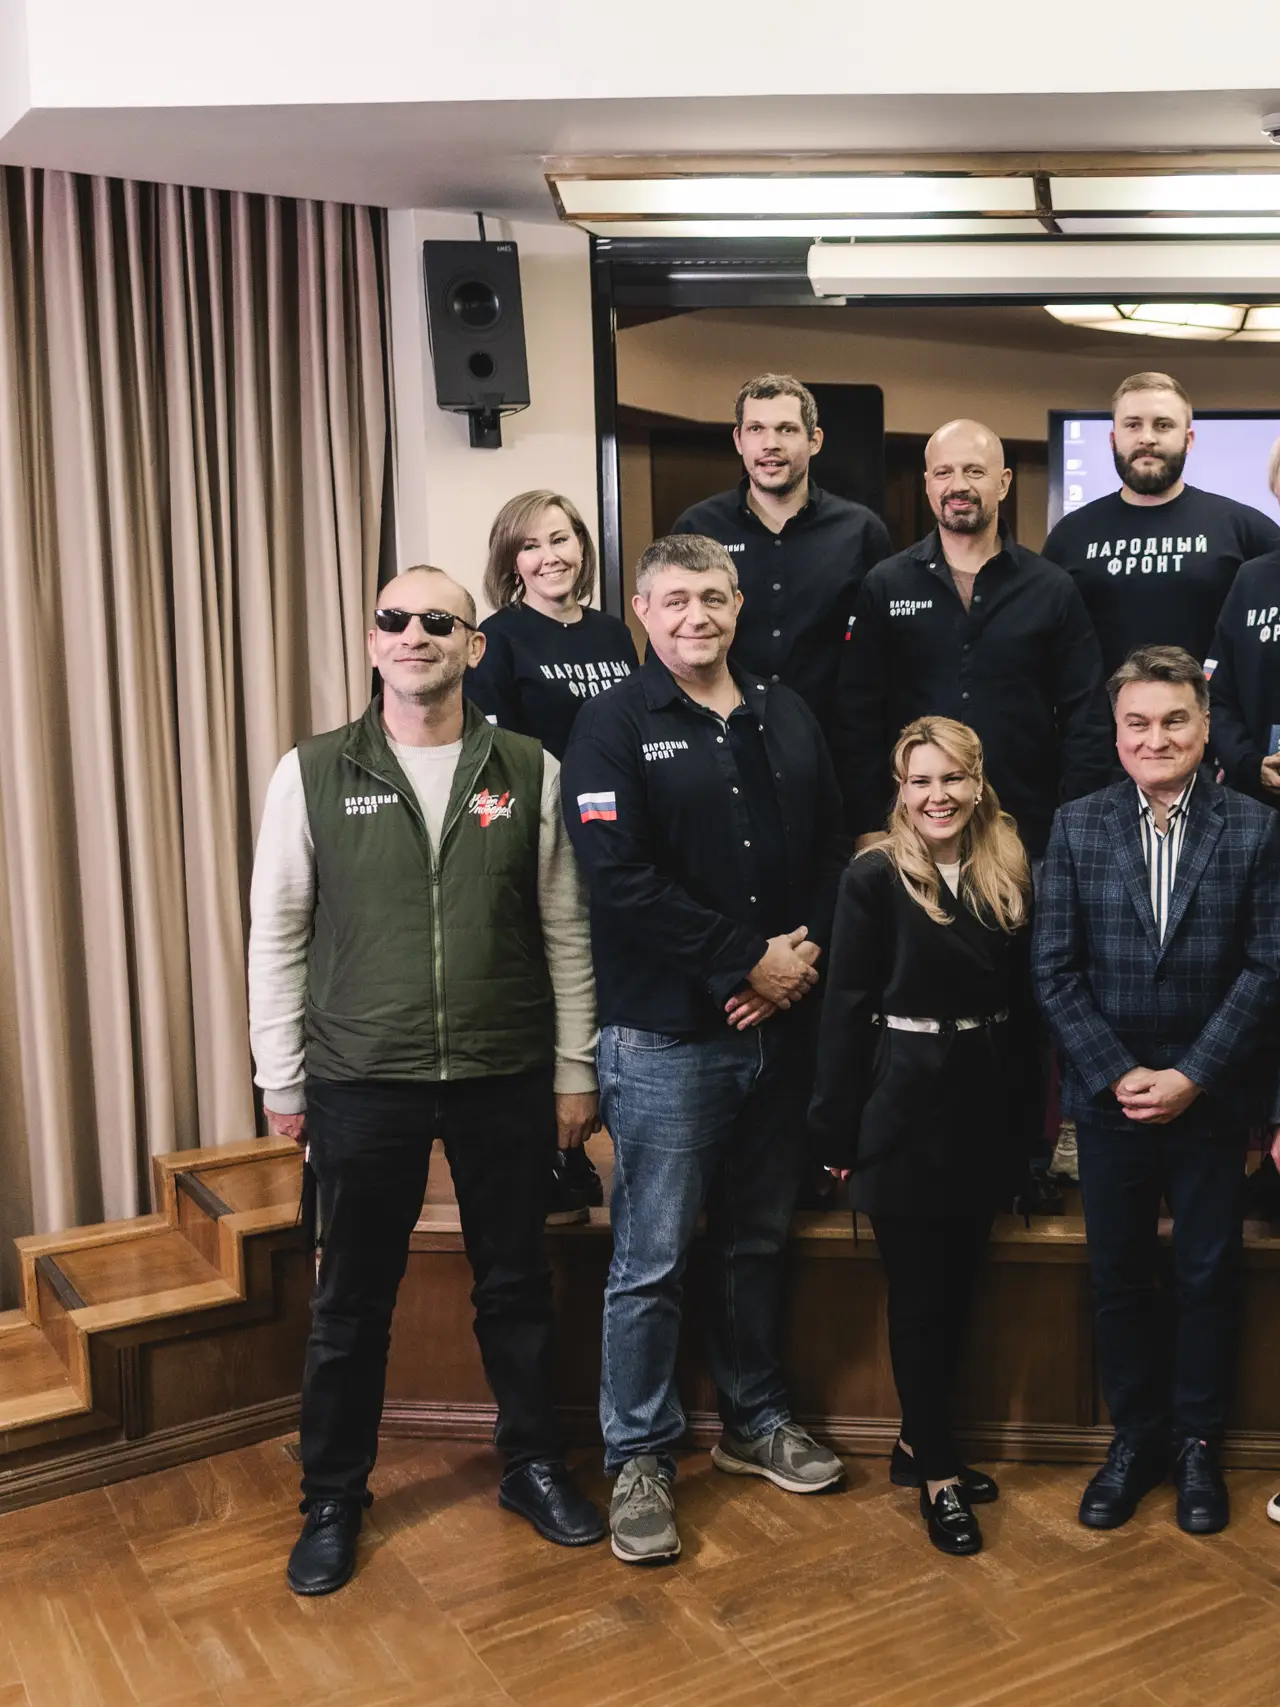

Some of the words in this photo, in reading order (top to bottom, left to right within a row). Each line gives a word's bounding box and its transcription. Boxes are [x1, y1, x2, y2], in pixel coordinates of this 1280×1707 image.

[1086, 534, 1208, 559] НАРОДНЫЙ
[1107, 554, 1184, 575] ФРОНТ
[889, 599, 933, 609] НАРОДНЫЙ
[889, 607, 916, 617] ФРОНТ
[540, 660, 631, 681] НАРОДНЫЙ
[569, 678, 622, 698] ФРОН
[642, 739, 689, 754] НАРОДНЫЙ
[645, 749, 675, 761] ФРОНТ
[344, 793, 399, 807] НАРОДНЫЙ
[346, 804, 378, 815] ФРОНТ
